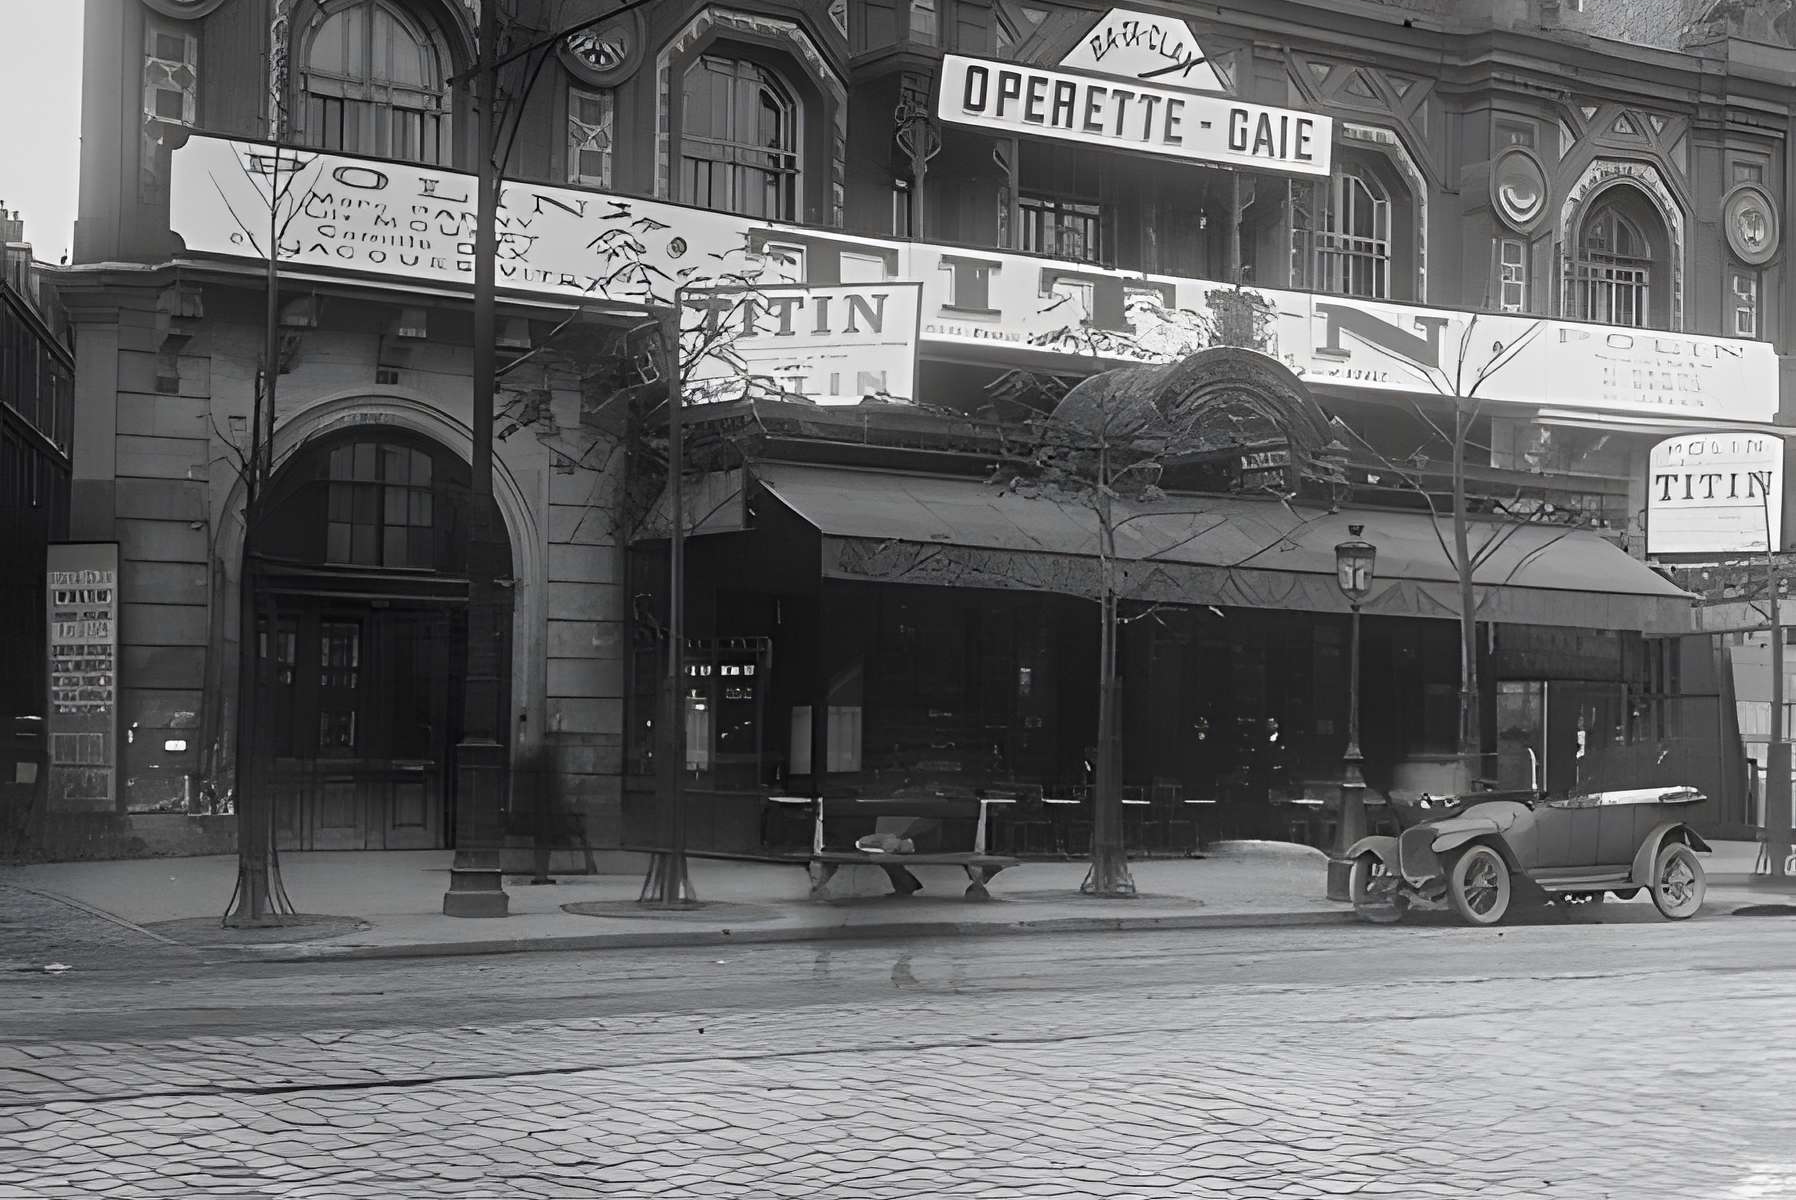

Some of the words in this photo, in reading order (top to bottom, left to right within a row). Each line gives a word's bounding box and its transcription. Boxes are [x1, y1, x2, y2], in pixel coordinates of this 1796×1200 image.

[962, 64, 1186, 144] OPERETTE
[1228, 107, 1314, 161] GAIE
[1655, 470, 1773, 502] TITIN
